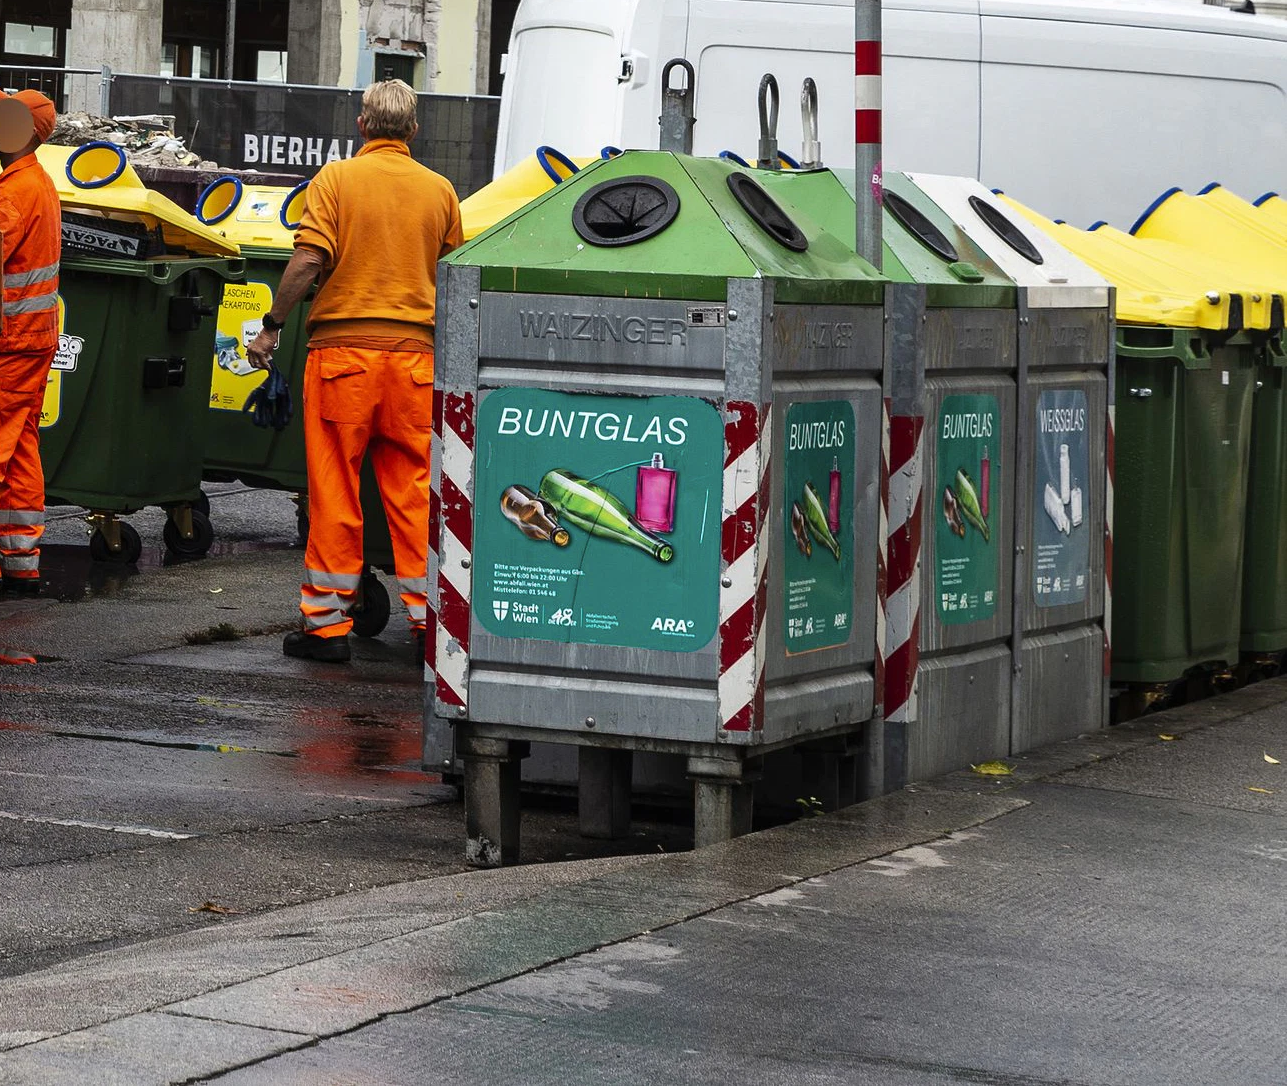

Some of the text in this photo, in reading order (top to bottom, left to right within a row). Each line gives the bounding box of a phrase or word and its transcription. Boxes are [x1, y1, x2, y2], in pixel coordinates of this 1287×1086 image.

[519, 310, 687, 346] WAIZINGER
[55, 352, 72, 360] einer,
[497, 407, 689, 446] BUNTGLAS
[943, 414, 993, 438] BUNTGLAS
[1041, 408, 1085, 433] WEISSGLAS
[789, 420, 845, 450] BUNTGLAS
[513, 602, 539, 613] Stadt
[513, 612, 539, 624] Wien
[651, 618, 687, 632] ARA
